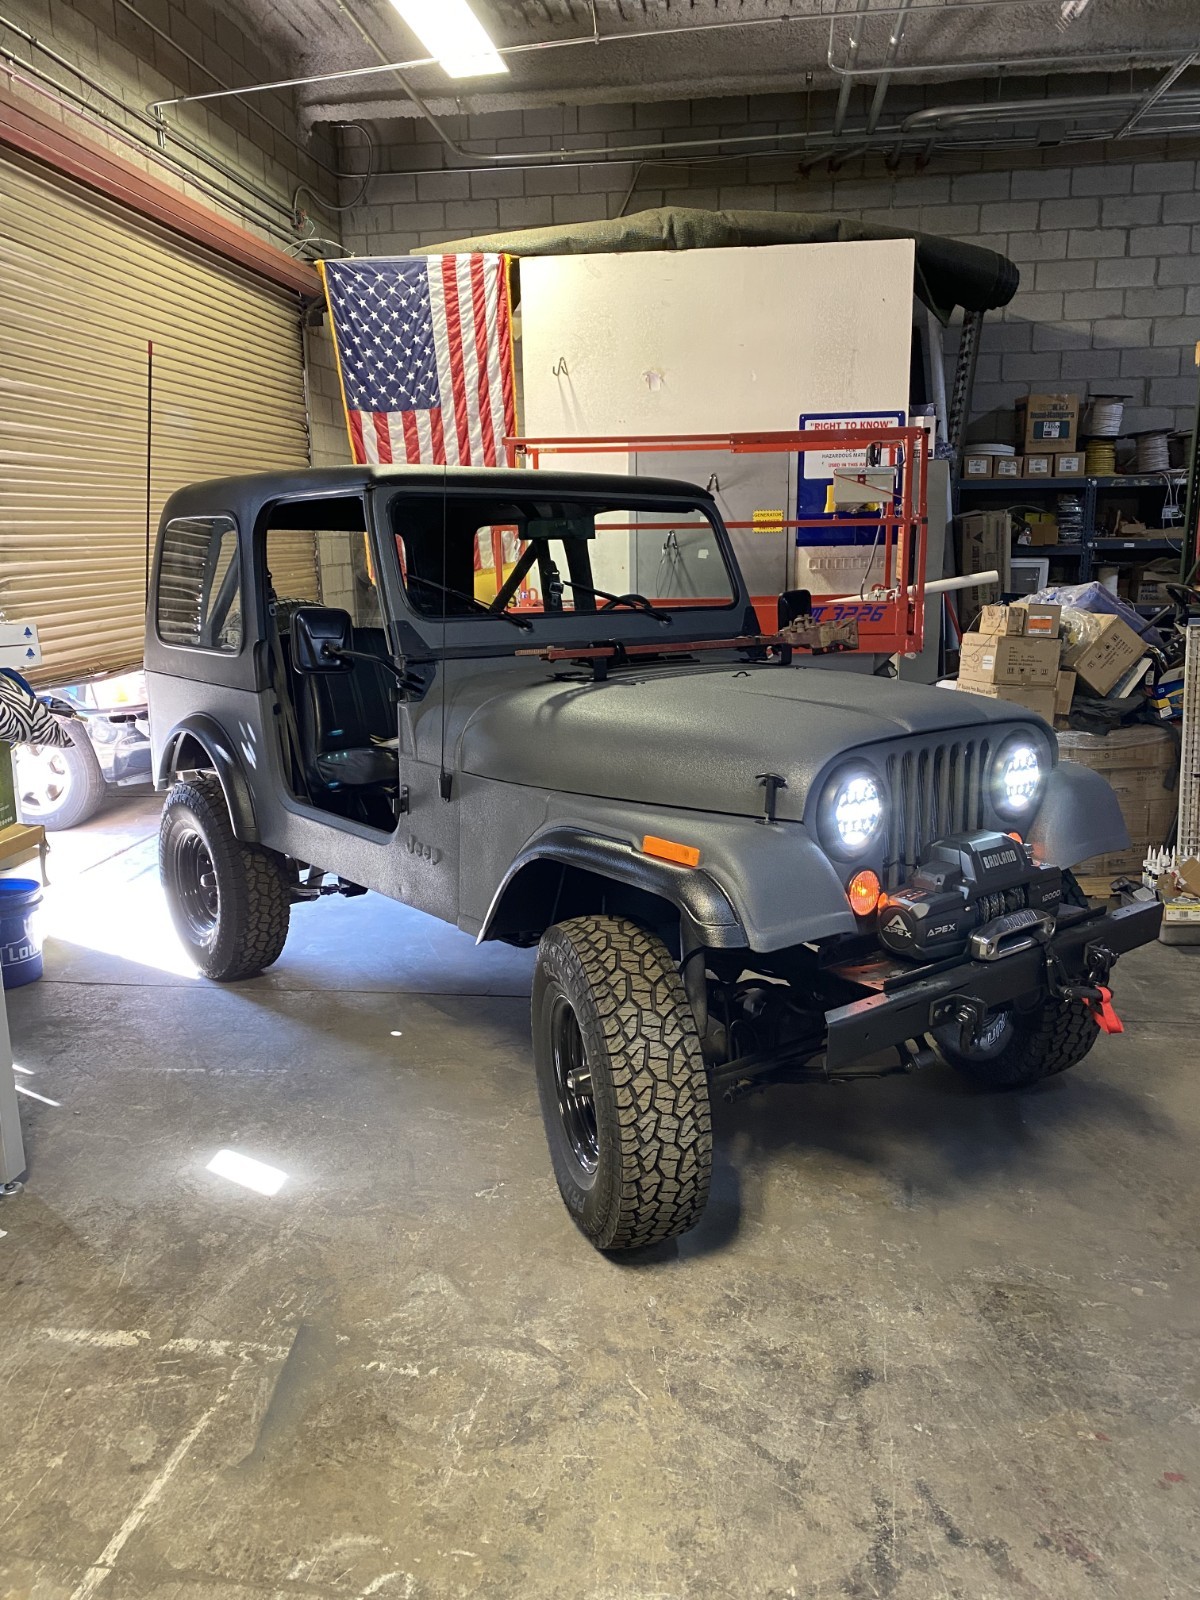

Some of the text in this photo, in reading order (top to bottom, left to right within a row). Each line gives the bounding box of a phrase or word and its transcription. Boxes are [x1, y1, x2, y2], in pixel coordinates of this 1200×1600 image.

[844, 422, 857, 430] TO
[827, 605, 886, 622] 3226
[406, 834, 442, 865] Jeep
[982, 849, 1017, 869] BADLAND
[882, 925, 913, 939] APEX
[926, 923, 956, 938] APEX
[8, 944, 39, 962] LOW
